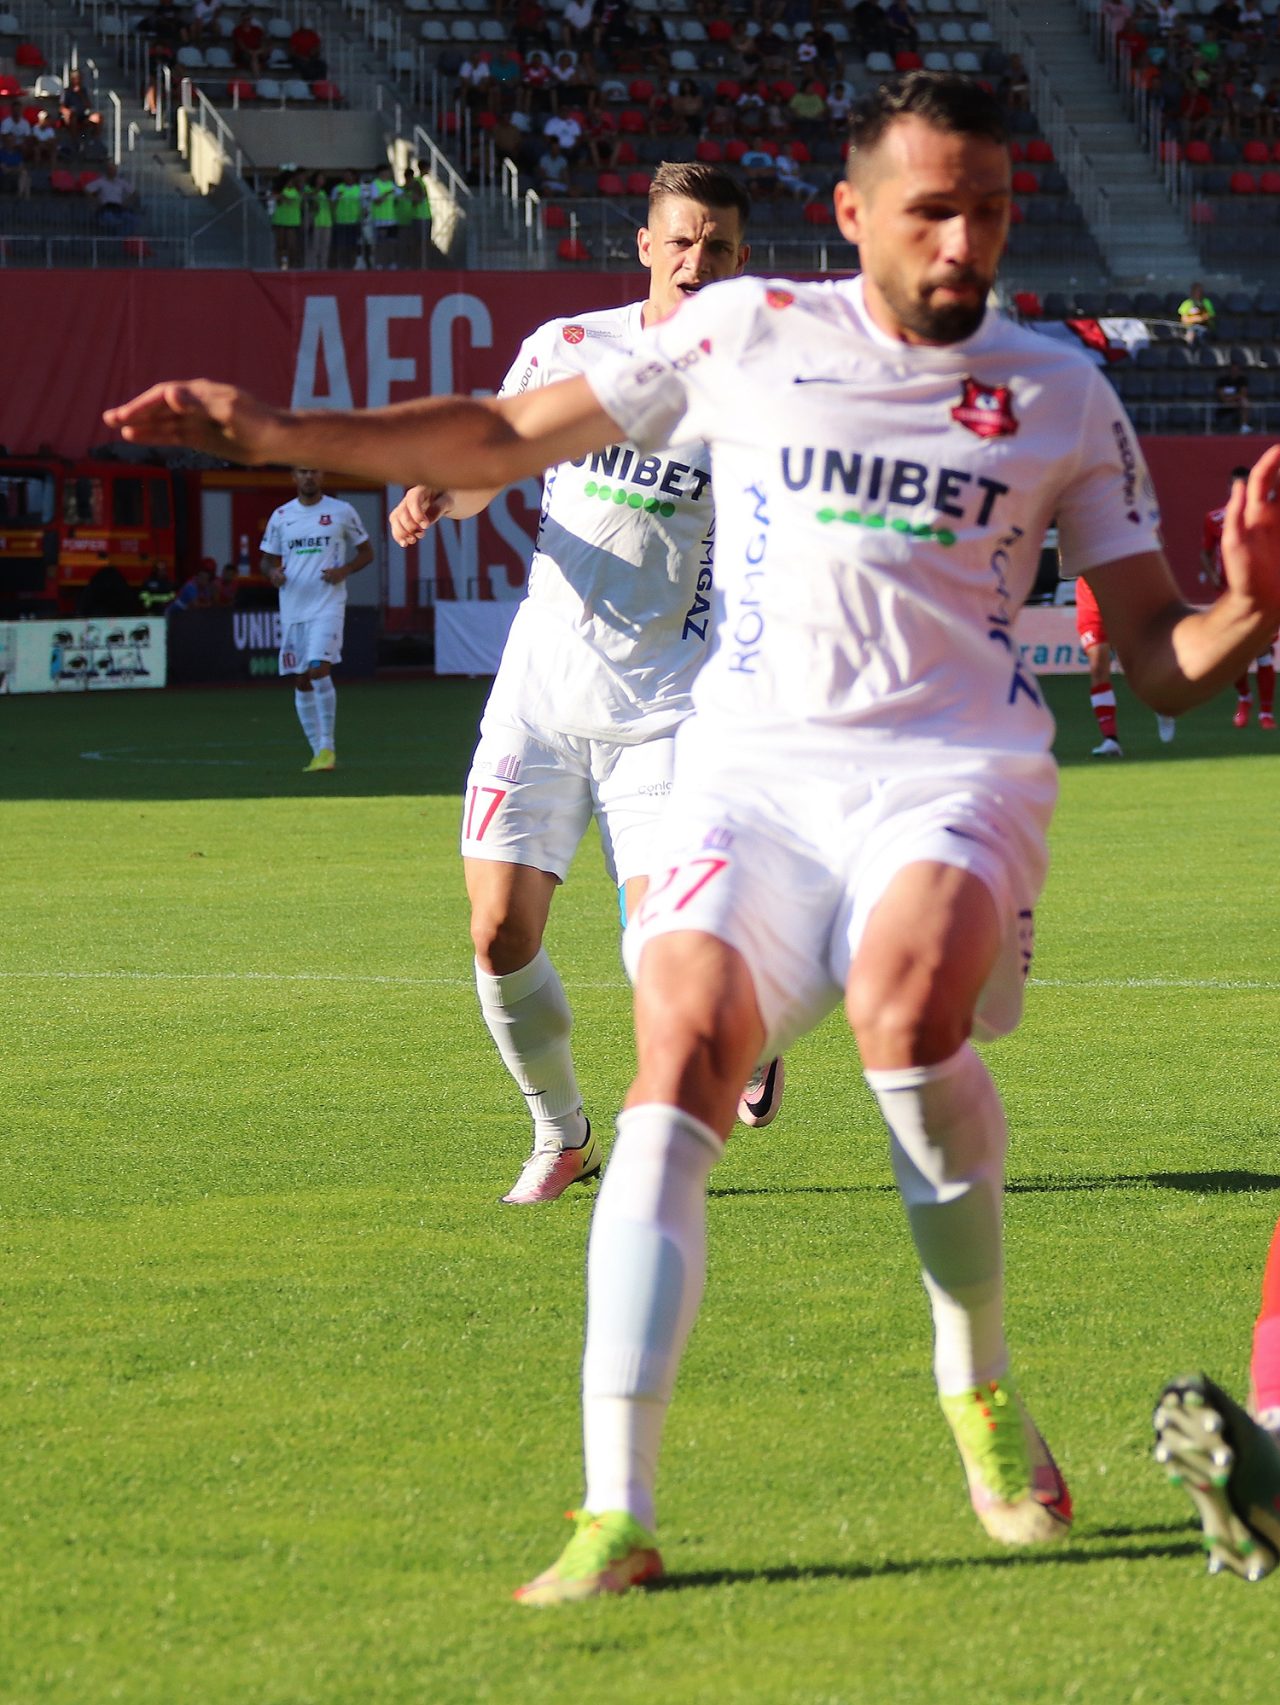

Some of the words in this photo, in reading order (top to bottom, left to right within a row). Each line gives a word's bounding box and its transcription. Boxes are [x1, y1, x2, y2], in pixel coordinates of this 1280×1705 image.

[291, 293, 493, 412] AFC
[781, 446, 1009, 527] UNIBET
[287, 536, 332, 549] UNIBET
[466, 785, 507, 841] 17
